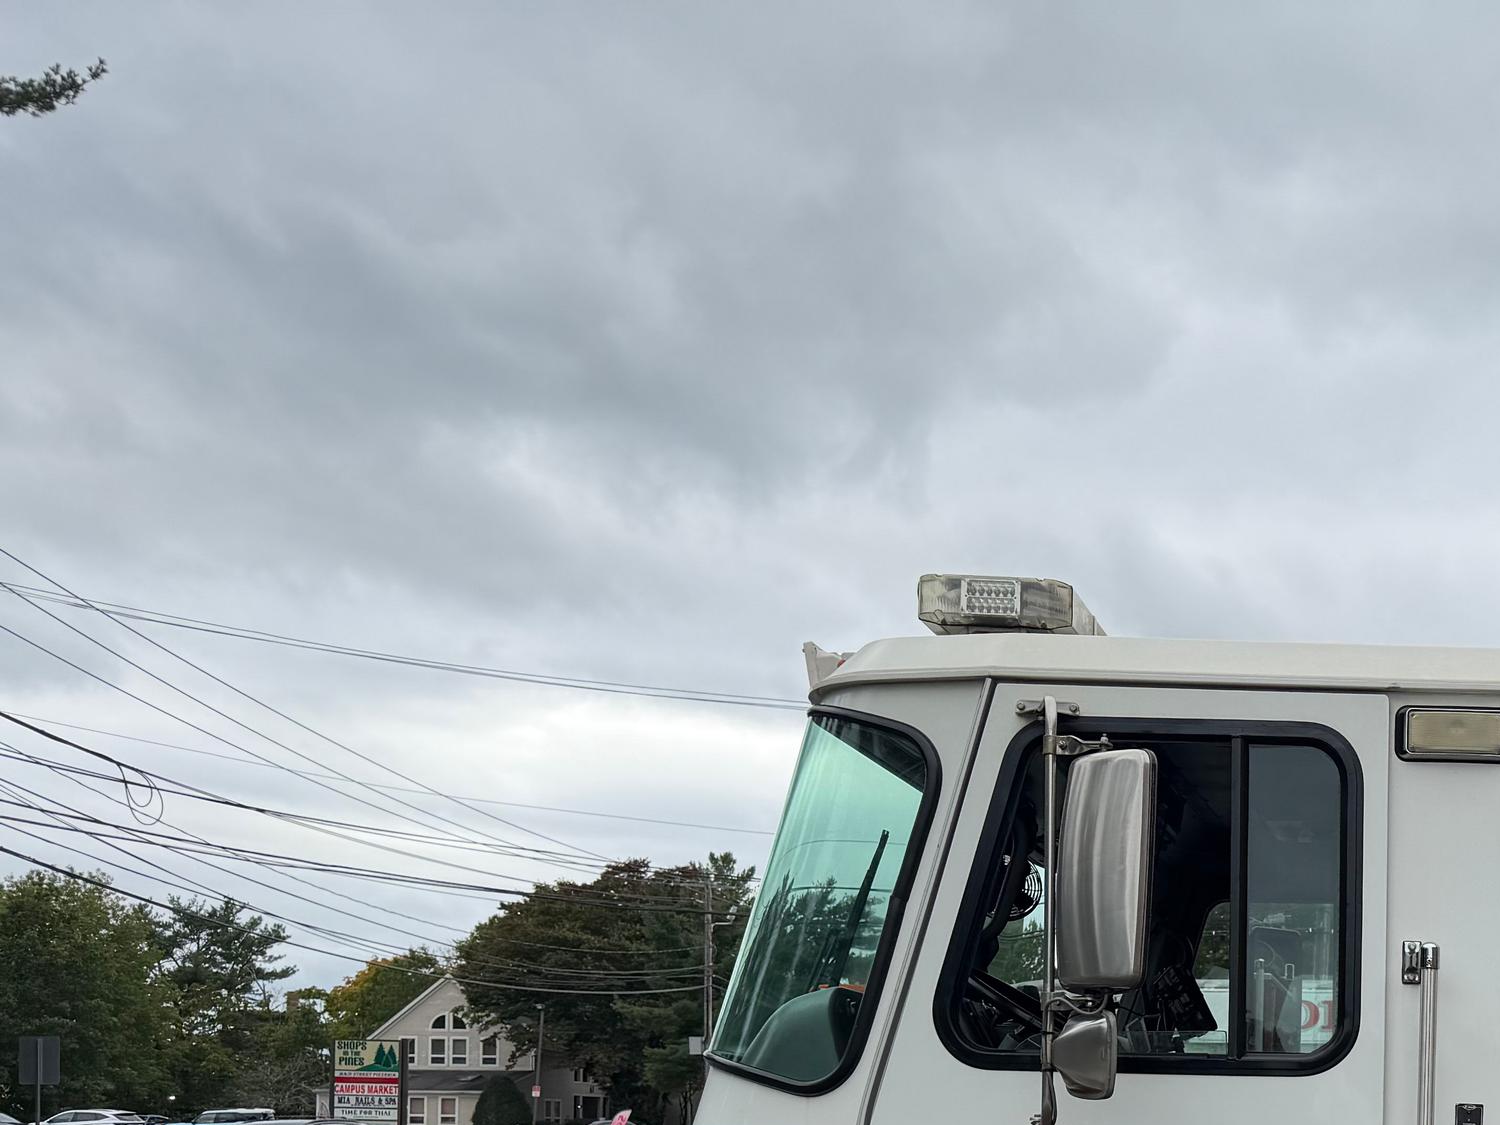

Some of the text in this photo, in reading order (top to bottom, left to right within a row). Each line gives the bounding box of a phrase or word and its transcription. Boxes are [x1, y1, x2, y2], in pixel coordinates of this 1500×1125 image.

[337, 1041, 367, 1050] SHOPS
[339, 1057, 365, 1066] PINES
[335, 1084, 398, 1095] CAMPUS MARKET
[337, 1096, 351, 1104] MIA
[355, 1096, 375, 1104] NAILS
[385, 1097, 397, 1105] SPA
